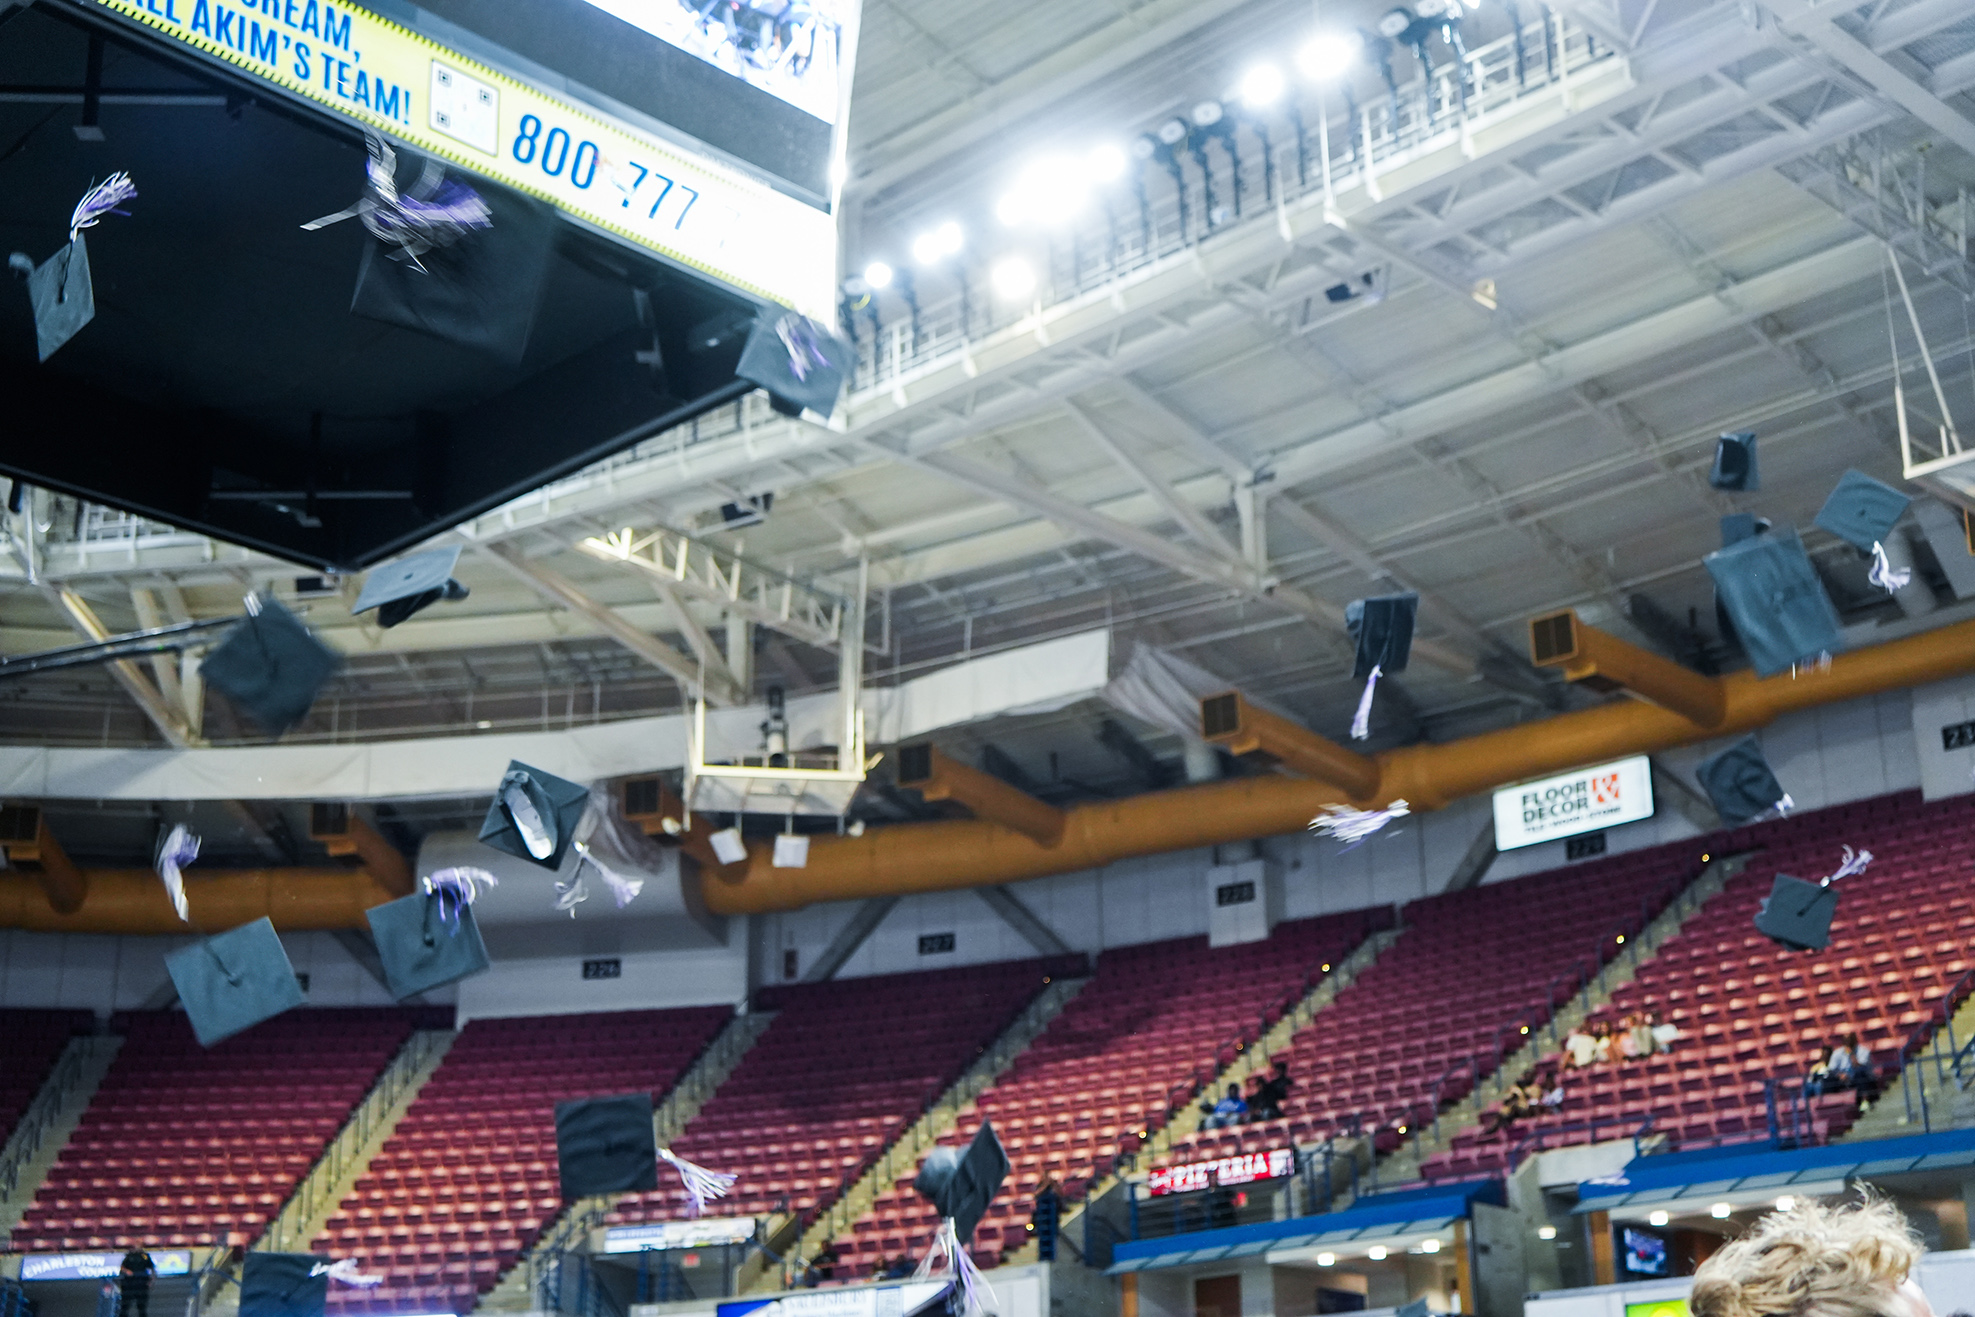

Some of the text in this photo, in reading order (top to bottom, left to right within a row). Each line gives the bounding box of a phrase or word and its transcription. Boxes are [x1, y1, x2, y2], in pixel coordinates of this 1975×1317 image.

[191, 0, 411, 125] AKIM'S TEAM!
[513, 114, 599, 189] 800
[1522, 781, 1587, 806] FLOOR
[1523, 797, 1588, 823] DECOR
[23, 1256, 105, 1279] CHARLESTON
